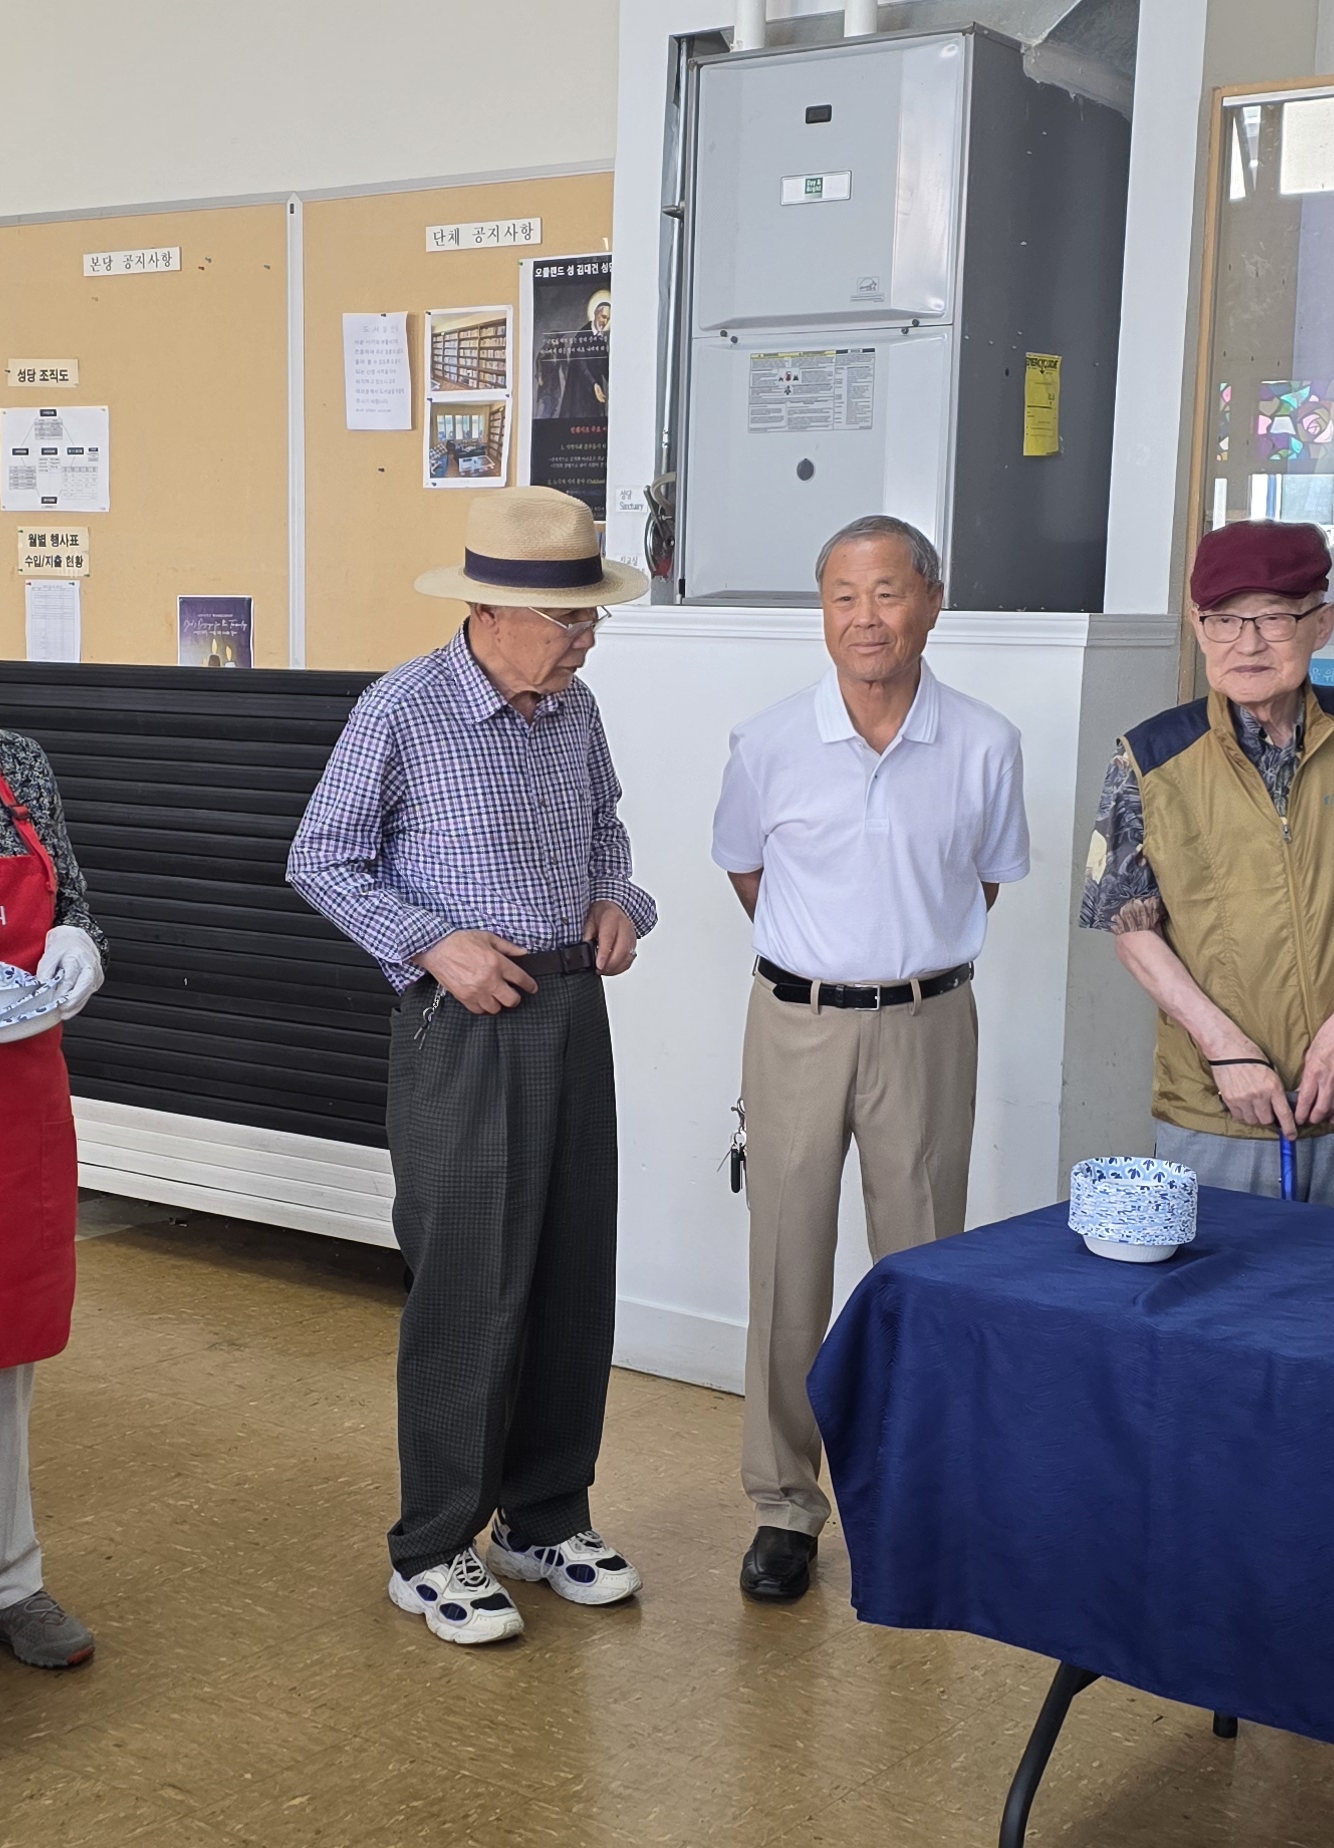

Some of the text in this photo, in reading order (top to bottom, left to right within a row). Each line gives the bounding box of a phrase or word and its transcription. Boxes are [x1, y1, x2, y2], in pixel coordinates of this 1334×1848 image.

[433, 222, 534, 247] 단체 공지사항
[90, 250, 173, 272] 본당 공지사항
[17, 369, 70, 383] 성당 조직도
[28, 533, 80, 548] 월별 행사표
[24, 555, 84, 568] 수입/지출 현황
